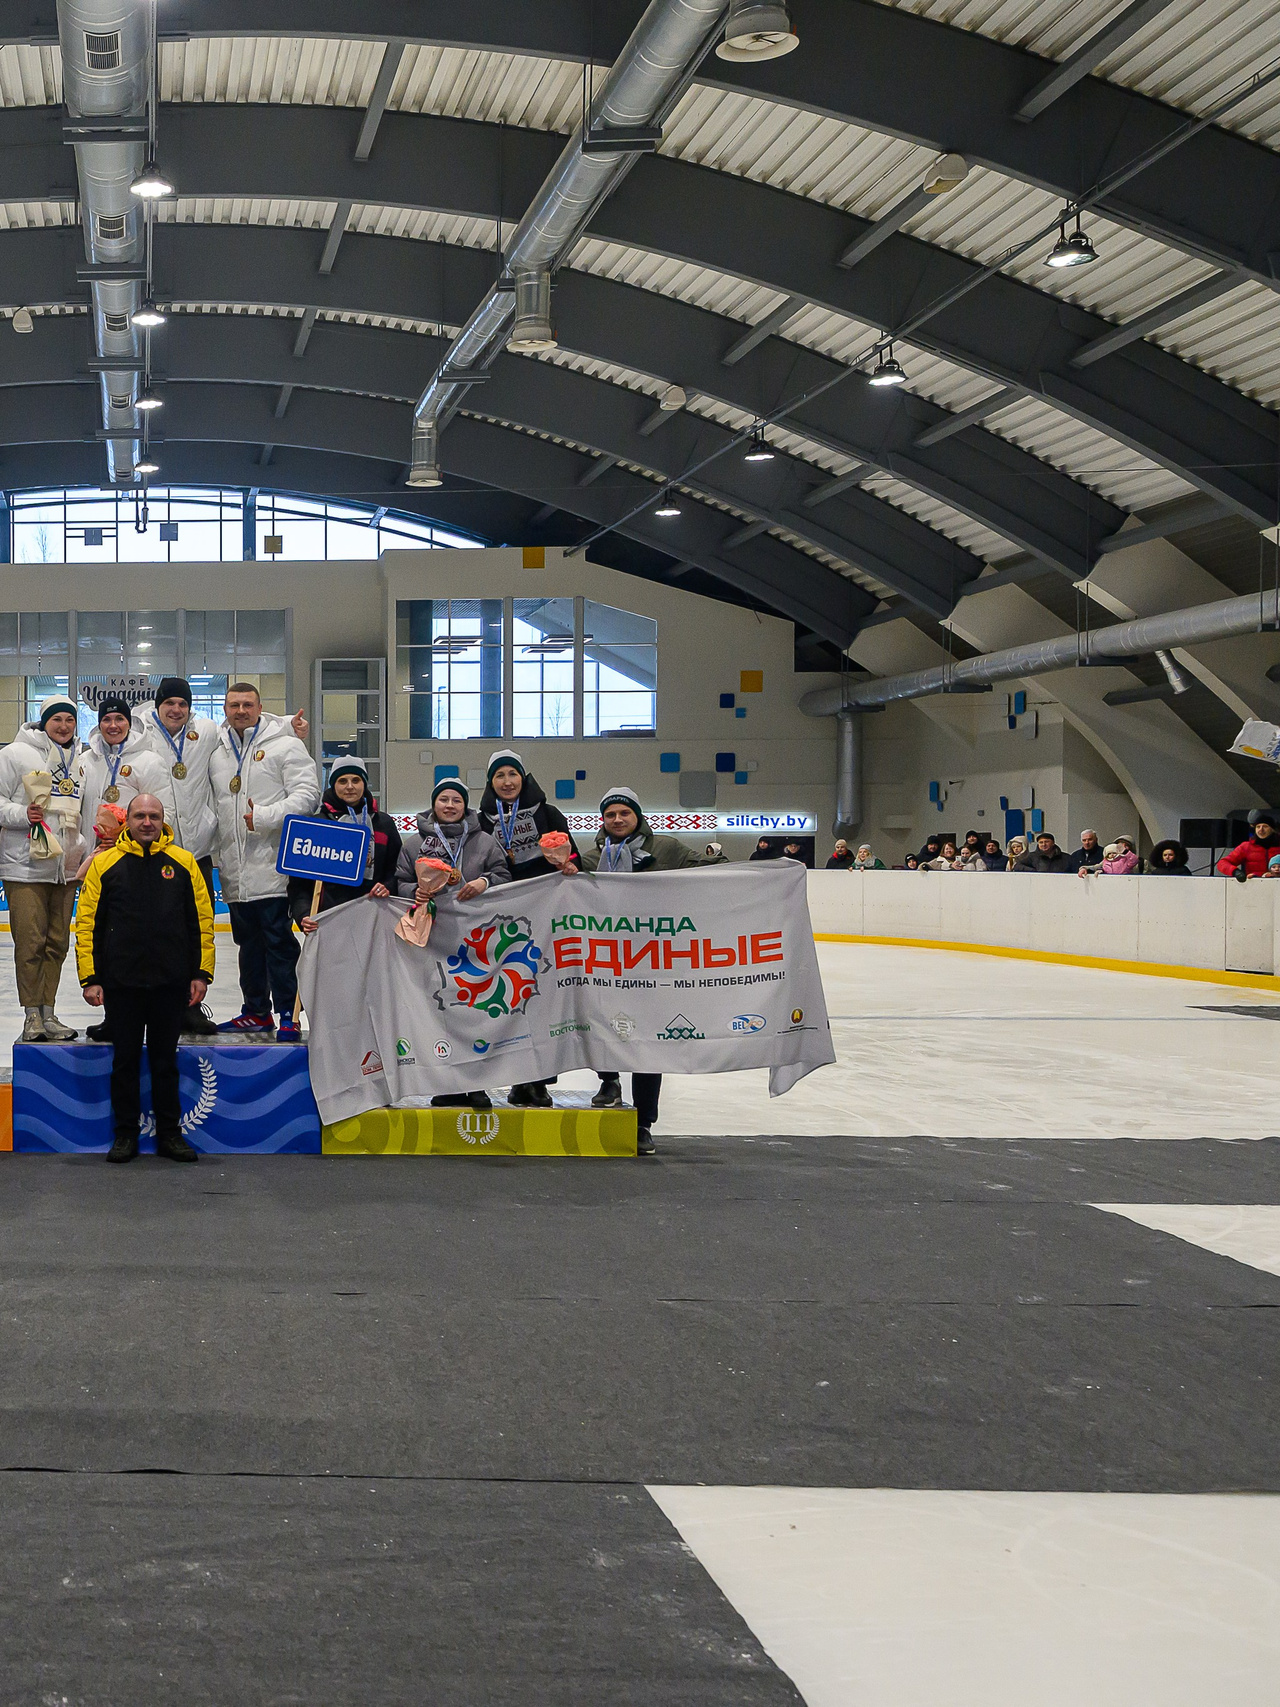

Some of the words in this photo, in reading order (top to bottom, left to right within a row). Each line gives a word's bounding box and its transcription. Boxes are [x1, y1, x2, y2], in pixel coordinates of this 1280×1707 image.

[111, 678, 144, 687] КАФЕ
[726, 815, 807, 829] silichy.by
[292, 837, 353, 863] Единые
[551, 915, 696, 937] КОМАНДА
[553, 930, 784, 976] ЕДИНЫЕ
[557, 977, 590, 989] КОГДА
[593, 978, 612, 988] МЫ
[615, 979, 657, 989] ЕДИНЫ
[674, 979, 695, 989] МЫ
[699, 971, 786, 988] НЕПОБЕДИМЫ!
